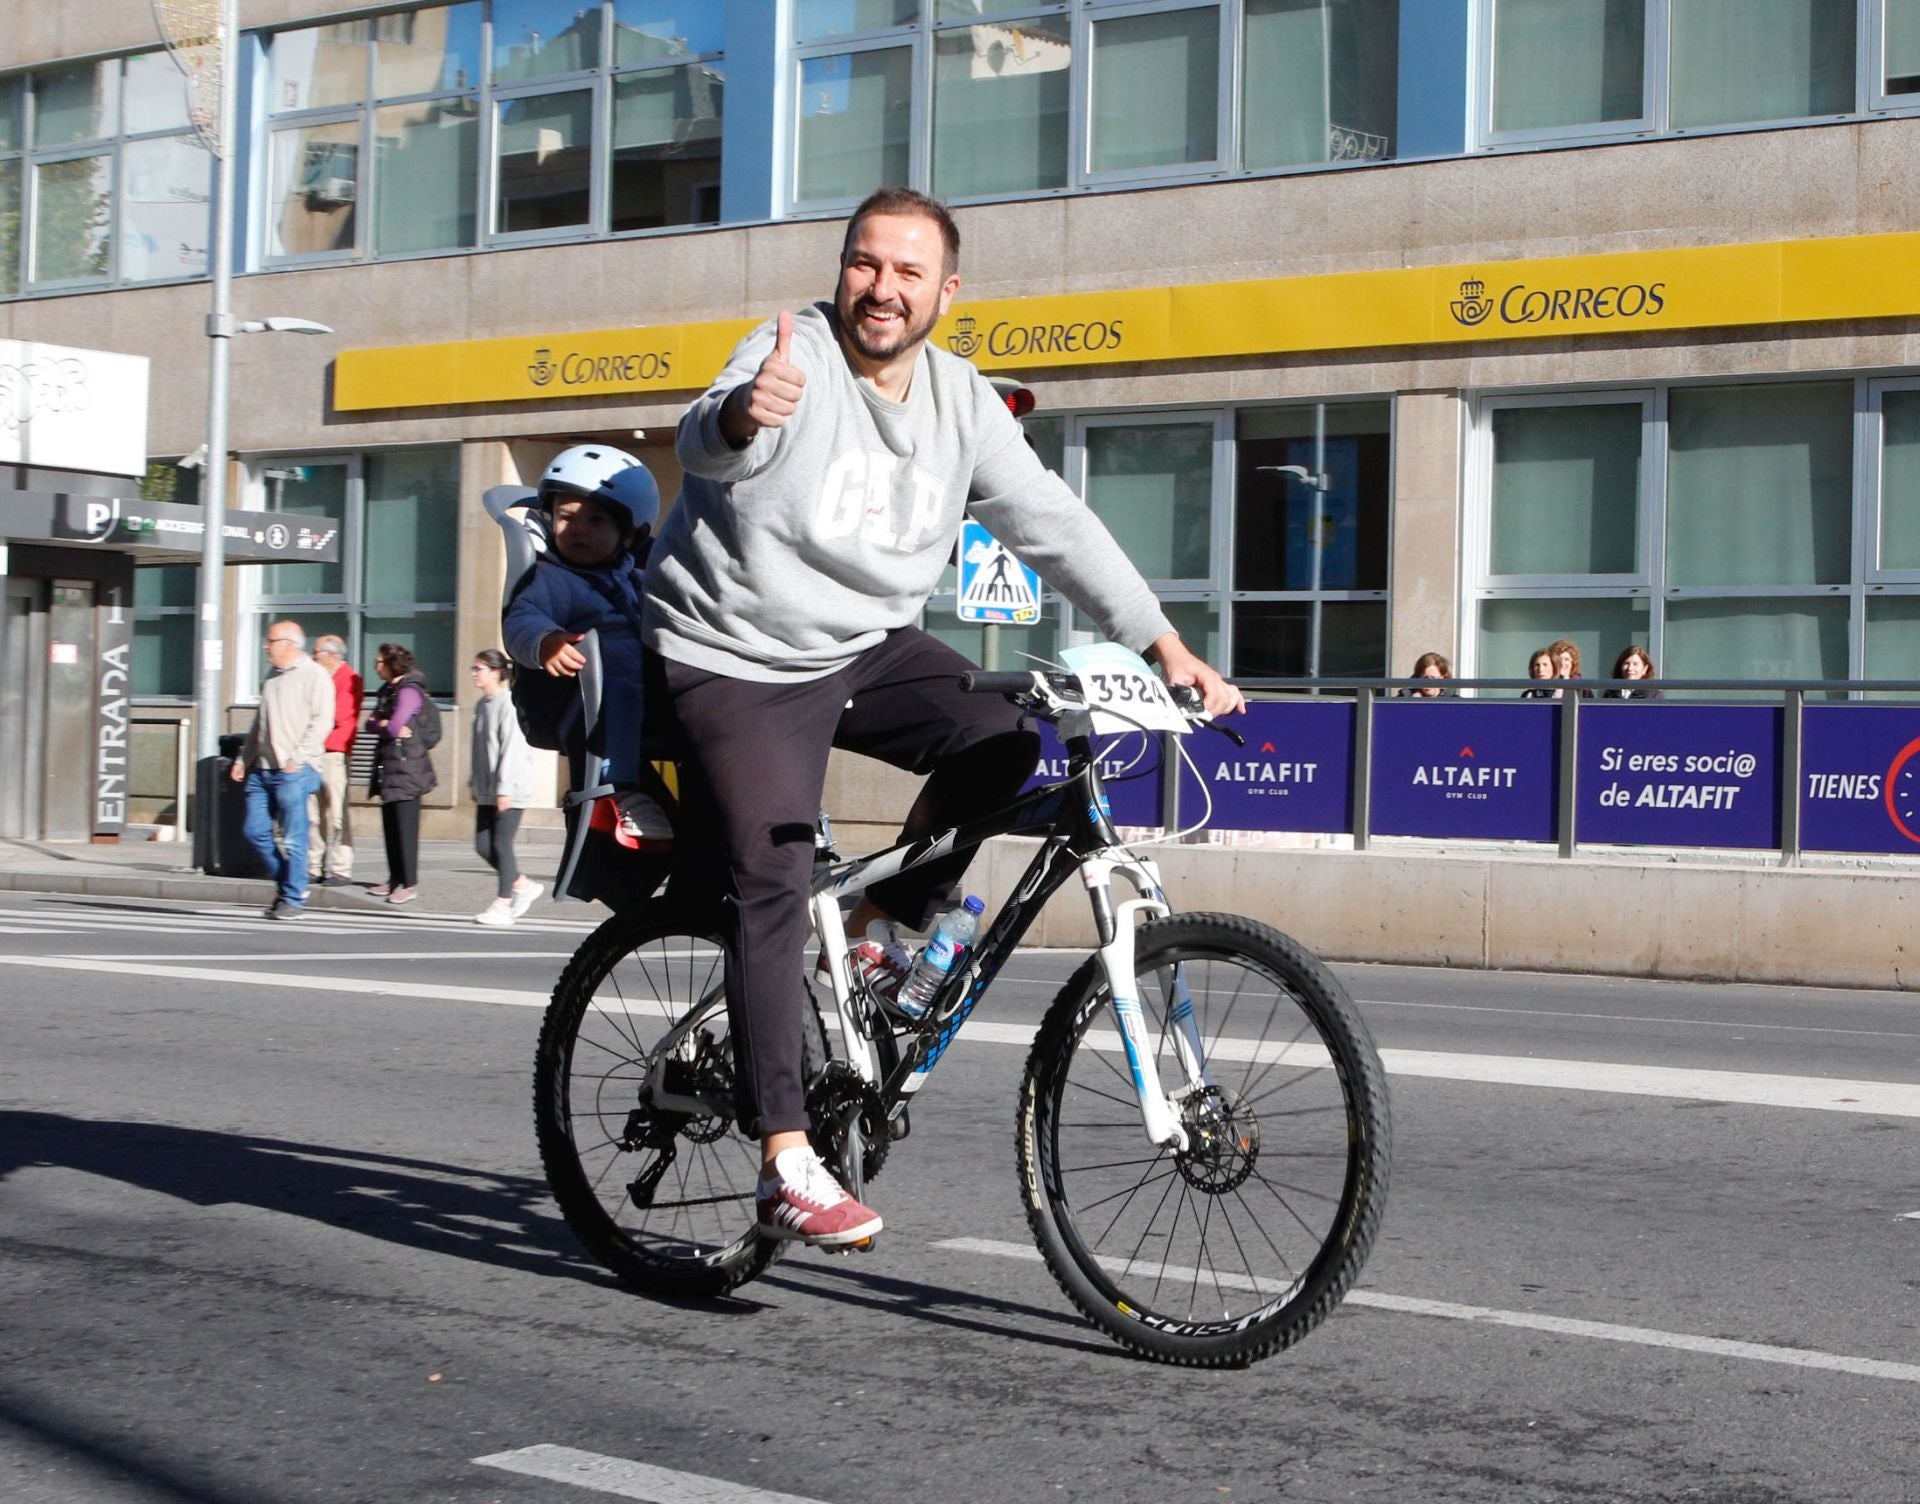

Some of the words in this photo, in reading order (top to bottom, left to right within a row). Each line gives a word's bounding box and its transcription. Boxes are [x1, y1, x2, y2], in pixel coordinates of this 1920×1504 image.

[1500, 283, 1665, 324] CORREOS
[988, 320, 1123, 356] CORREOS
[561, 351, 672, 384] CORREOS
[107, 587, 125, 624] 1
[1091, 674, 1167, 707] 3324
[97, 644, 129, 824] ENTRADA
[1034, 758, 1125, 778] ALTIT
[1214, 761, 1318, 783] ALTAFIT
[1412, 766, 1517, 787] ALTAFIT
[1600, 747, 1624, 771] Si
[1628, 754, 1680, 772] eres
[1684, 749, 1757, 778] soci@
[1268, 788, 1289, 796] CLUB
[1467, 792, 1488, 800] CLUB
[1599, 782, 1631, 807] de
[1634, 784, 1741, 809] ALTAFIT
[1808, 774, 1881, 800] TIENES
